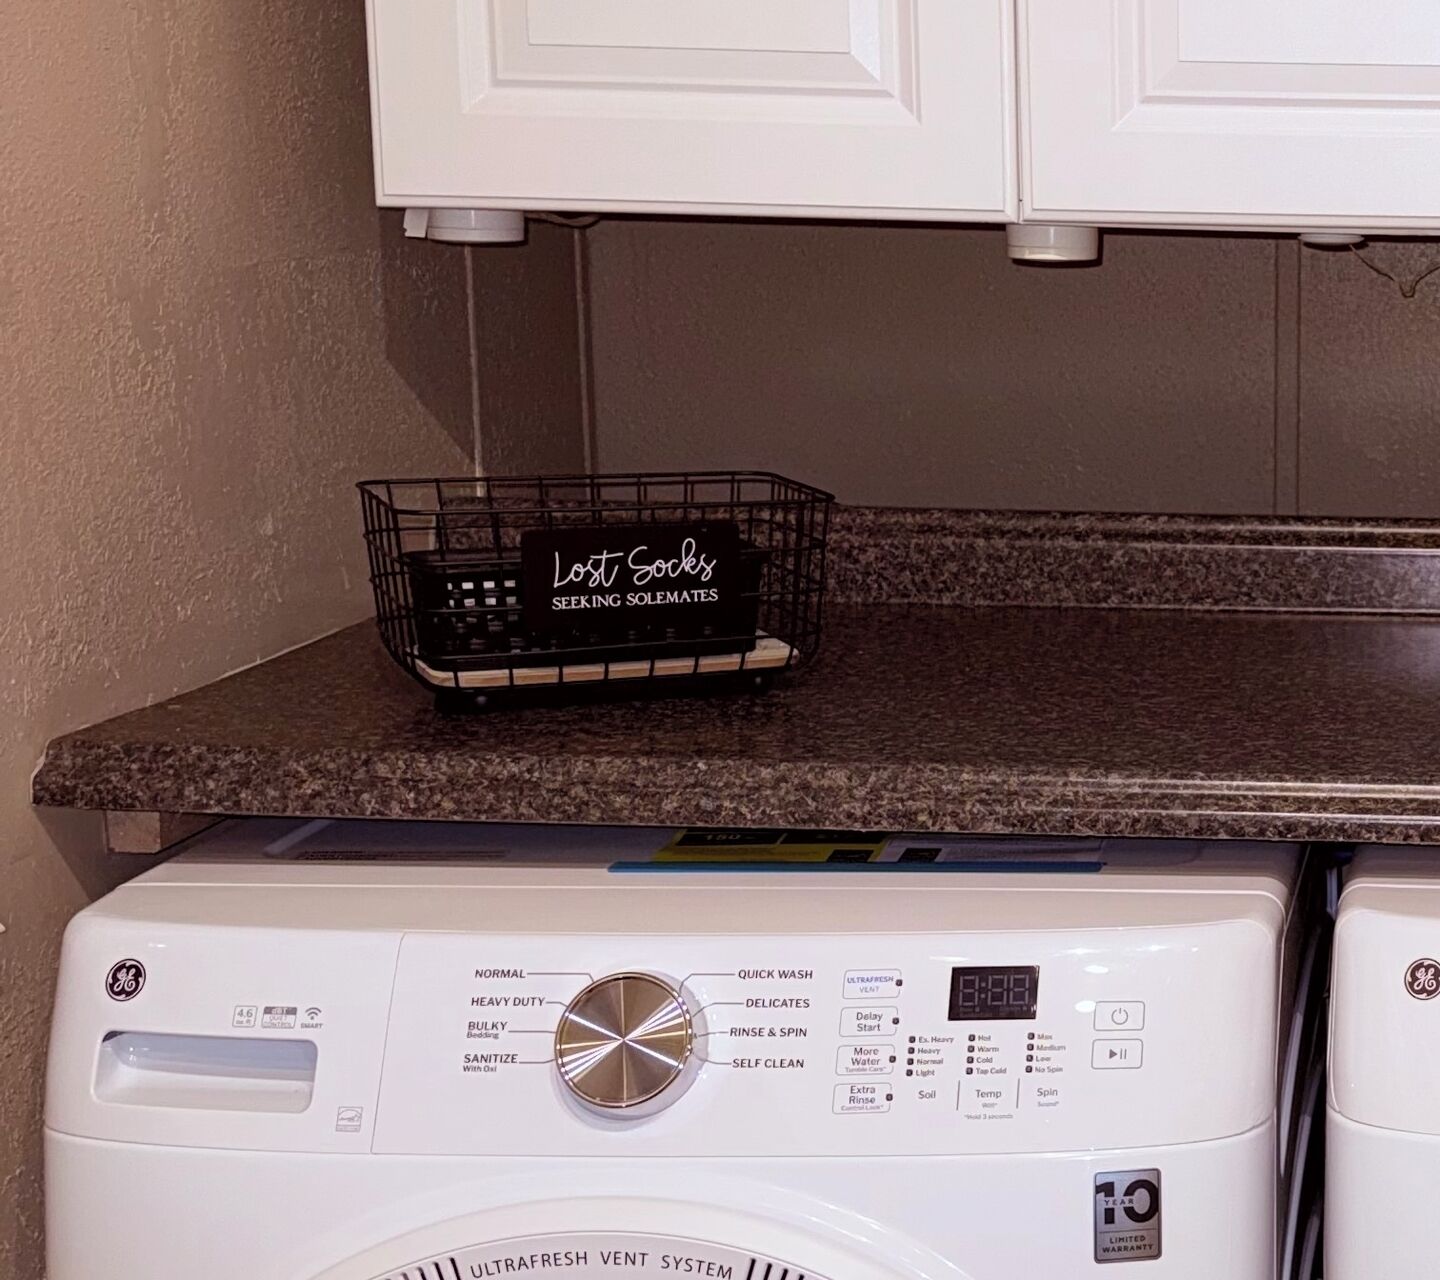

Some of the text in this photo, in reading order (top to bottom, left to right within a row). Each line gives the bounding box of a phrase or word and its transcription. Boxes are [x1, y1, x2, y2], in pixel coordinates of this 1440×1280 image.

[553, 537, 717, 588] Lost Socks
[552, 589, 718, 610] SEEKING SOLEMATES
[475, 969, 526, 979] NORMAL
[738, 969, 813, 980] QUICK WASH
[471, 997, 545, 1006] HEAVY DUTY
[746, 998, 810, 1008] DELICATES
[856, 1012, 883, 1021] Delay
[468, 1021, 508, 1031] BULKY
[857, 1023, 881, 1032] Start
[467, 1032, 500, 1040] Bedding
[730, 1027, 808, 1037] RINSE & SPIN
[853, 1047, 879, 1056] More
[464, 1054, 518, 1064] SANITIZE
[733, 1059, 804, 1068] SELF CLEAN
[851, 1058, 881, 1066] Water
[850, 1086, 876, 1094] Extra
[918, 1090, 936, 1099] Soil
[976, 1089, 1002, 1099] Temp
[1037, 1088, 1058, 1097] Spin
[849, 1096, 876, 1104] Rinse
[1096, 1179, 1159, 1225] 10
[1109, 1235, 1146, 1244] LIMITED
[1102, 1244, 1154, 1253] WARRANTY
[470, 1251, 733, 1280] ULTRAFRESH VENT SYSTEM
